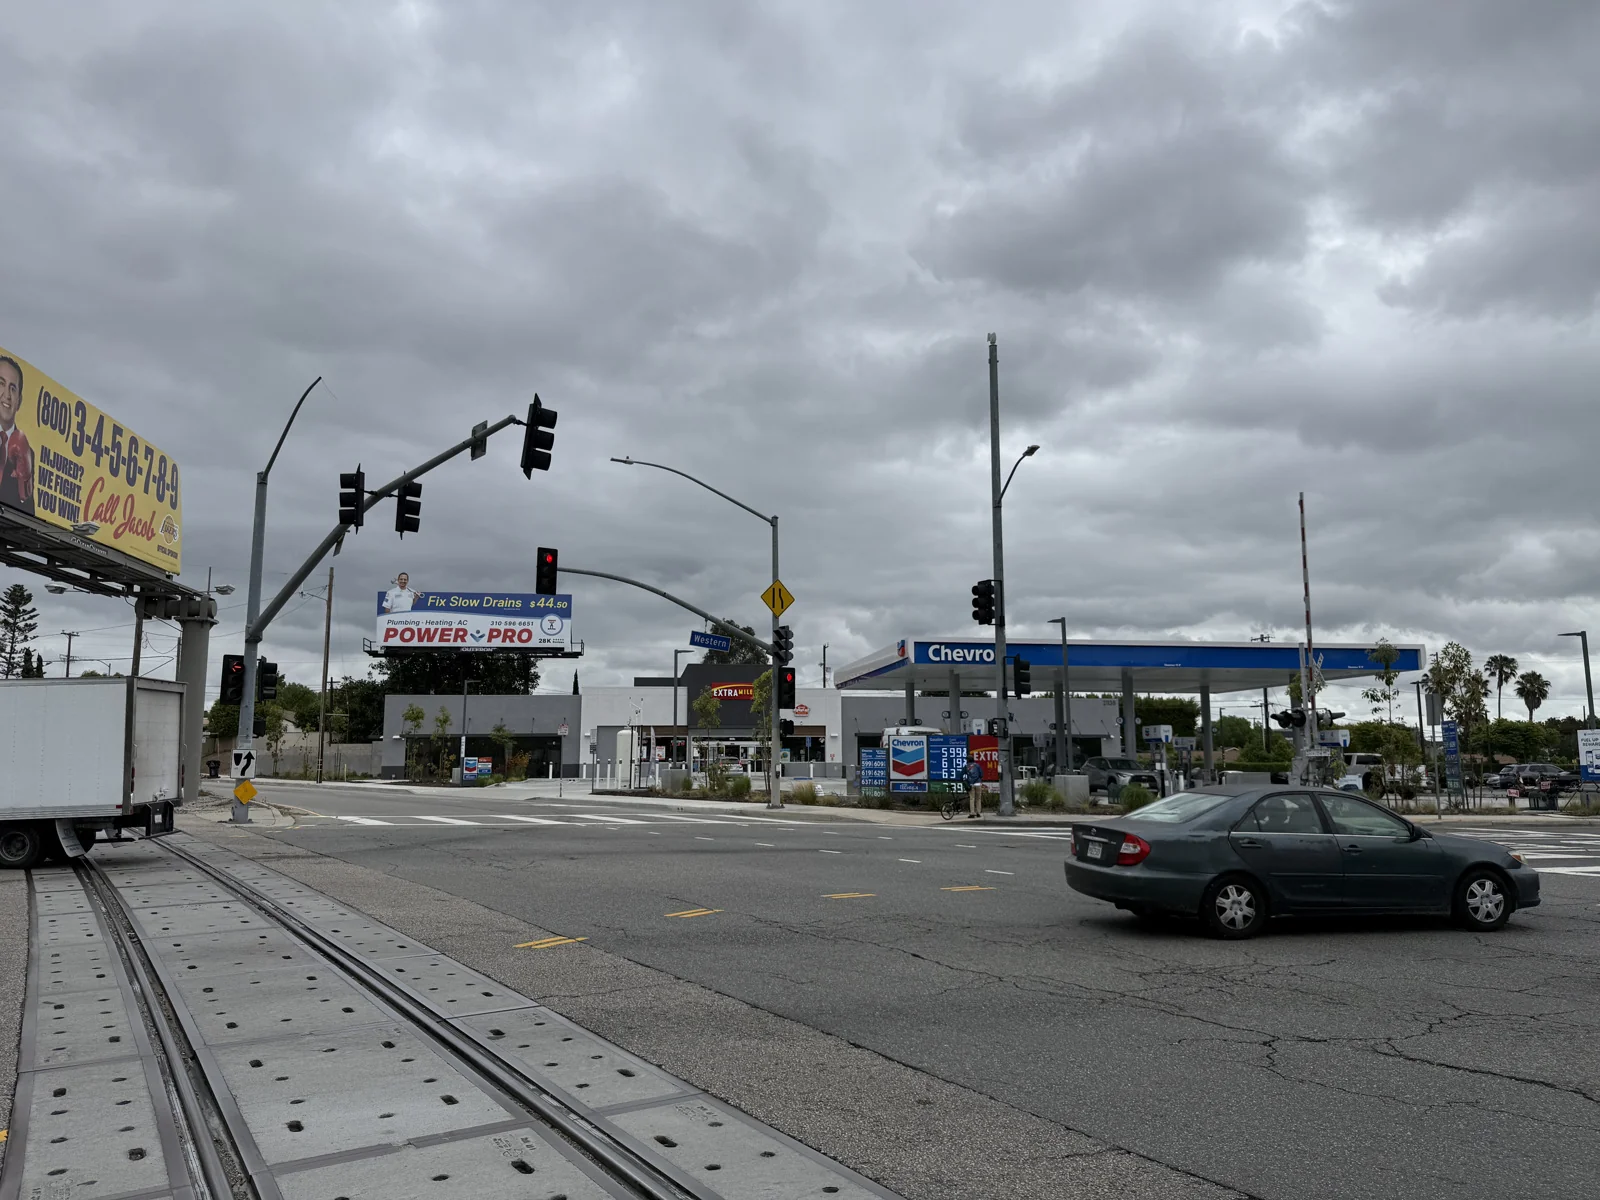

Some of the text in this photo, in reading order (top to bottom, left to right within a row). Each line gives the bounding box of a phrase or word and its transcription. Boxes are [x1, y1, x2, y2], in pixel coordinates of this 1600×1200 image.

[37, 386, 179, 510] (800) 3-4-5-6-7-8-9
[40, 444, 84, 483] INJURED?
[38, 465, 82, 504] WE FIGHT.
[37, 488, 80, 524] YOU WIN!
[83, 476, 156, 541] Call Jacob
[427, 596, 568, 609] Fix Slow Drains $44.50
[387, 619, 420, 627] Plumbing
[383, 627, 533, 643] POWER PRO
[694, 634, 727, 648] Western
[928, 644, 995, 662] Chevro
[713, 689, 738, 697] EXTRA
[974, 751, 998, 761] EXTR
